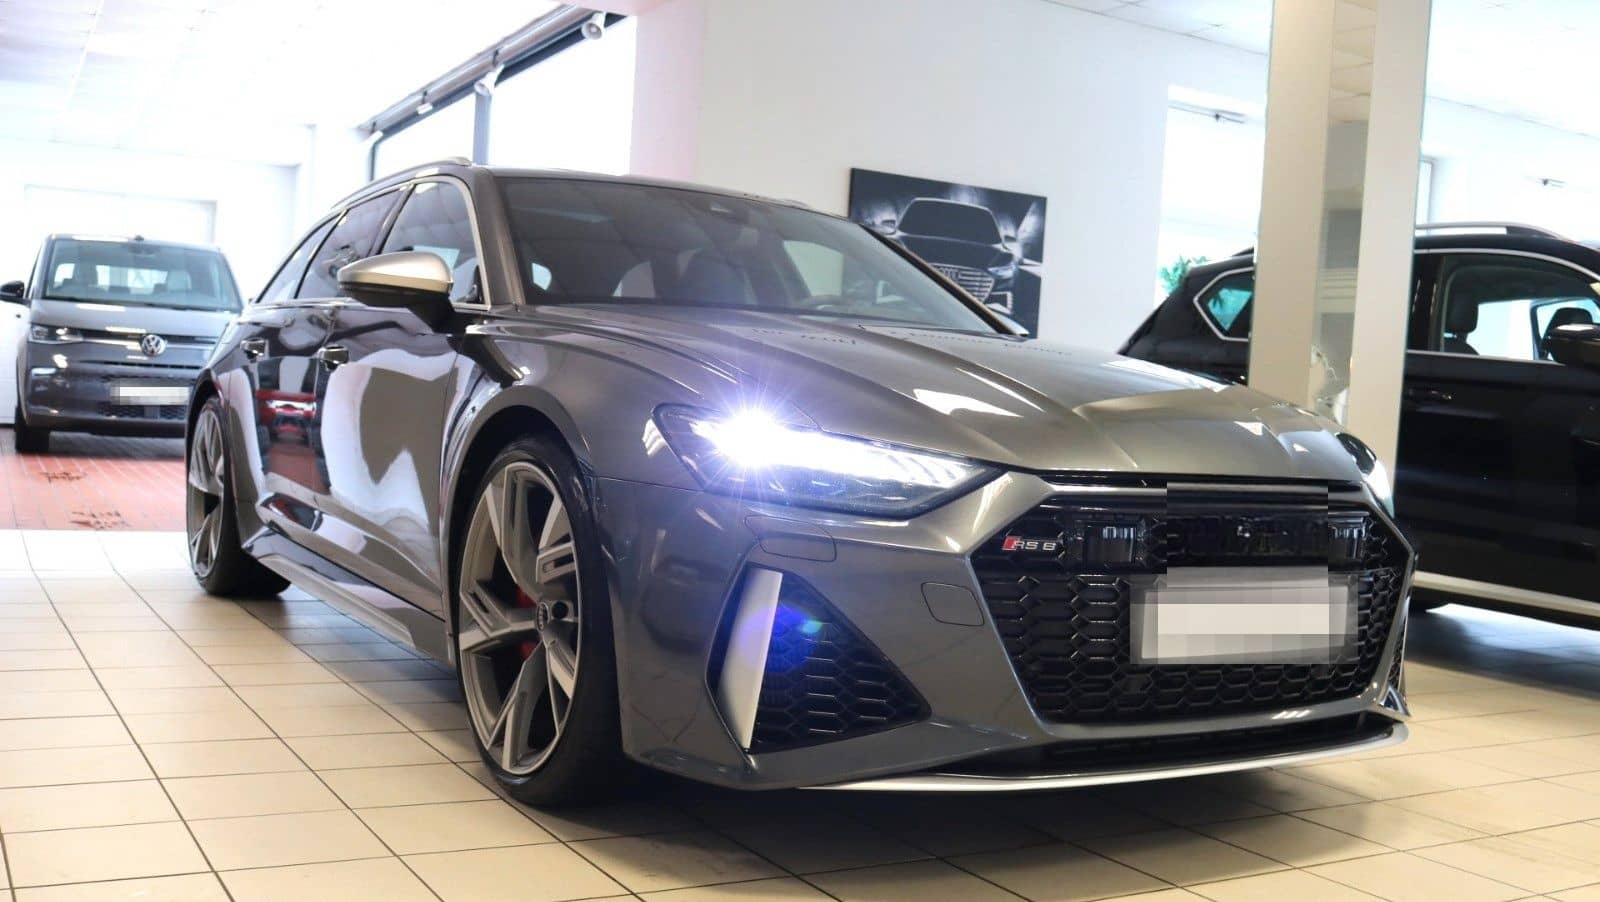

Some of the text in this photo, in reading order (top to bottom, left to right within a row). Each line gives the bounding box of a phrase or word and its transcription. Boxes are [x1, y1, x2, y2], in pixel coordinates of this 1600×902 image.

[142, 334, 166, 356] VW
[1013, 540, 1056, 551] RS 6
